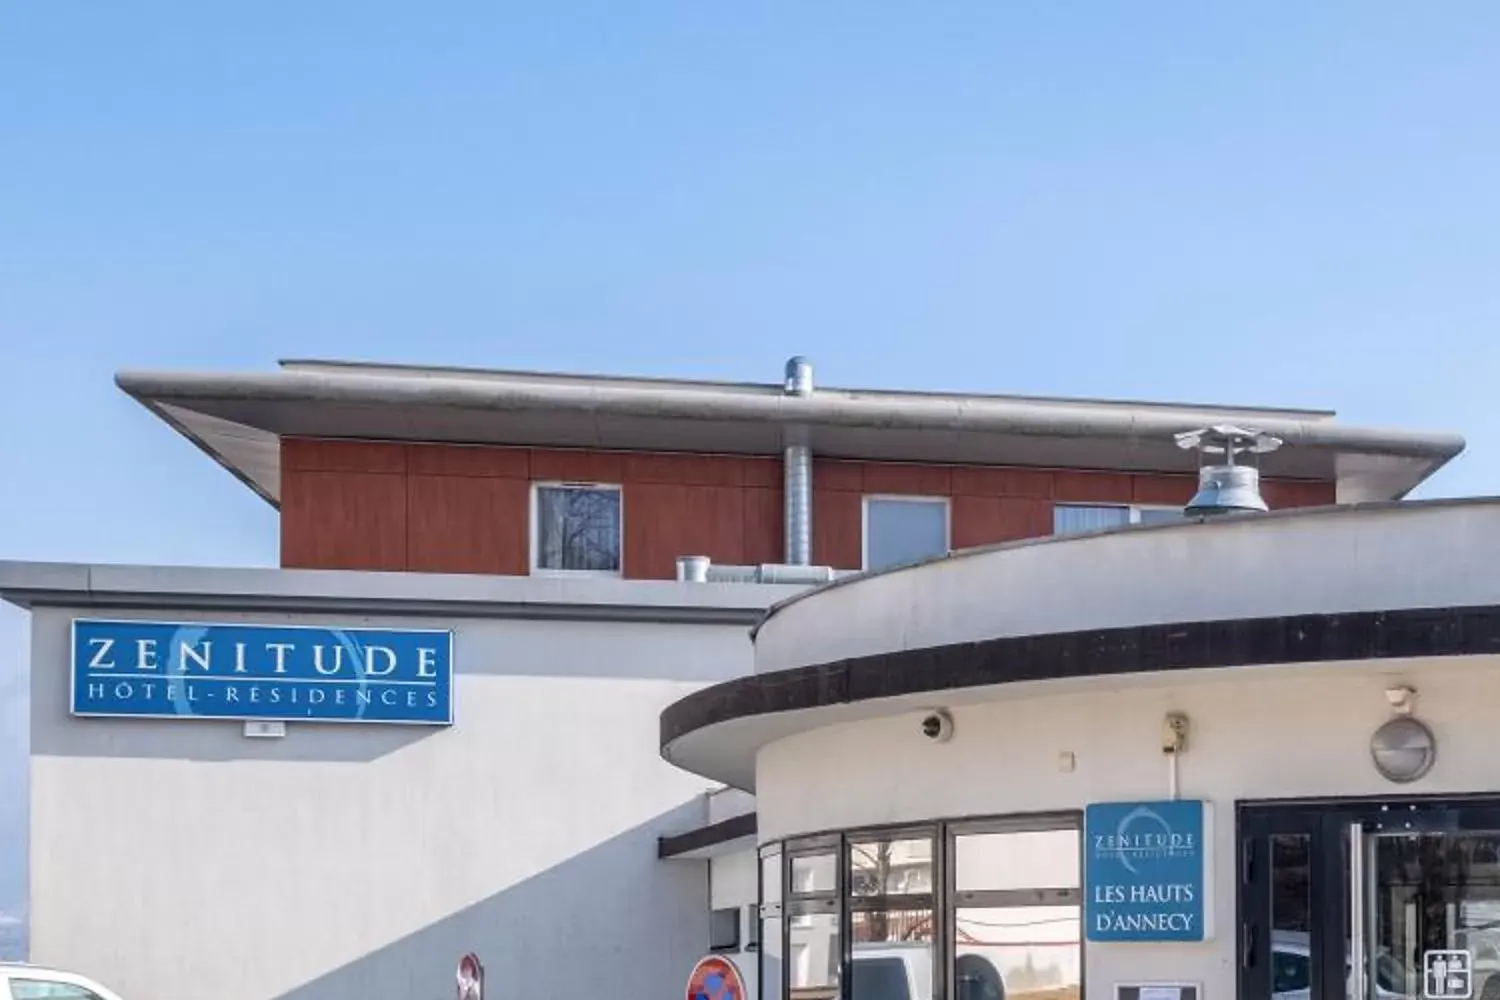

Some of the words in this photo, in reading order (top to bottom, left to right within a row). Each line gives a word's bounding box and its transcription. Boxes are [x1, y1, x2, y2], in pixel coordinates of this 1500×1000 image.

[87, 637, 438, 678] ZENITUDE
[1095, 832, 1195, 849] ZENITUDE
[1095, 885, 1125, 903] LES
[1130, 883, 1194, 903] HAUTS
[1096, 910, 1194, 931] D'ANNECY
